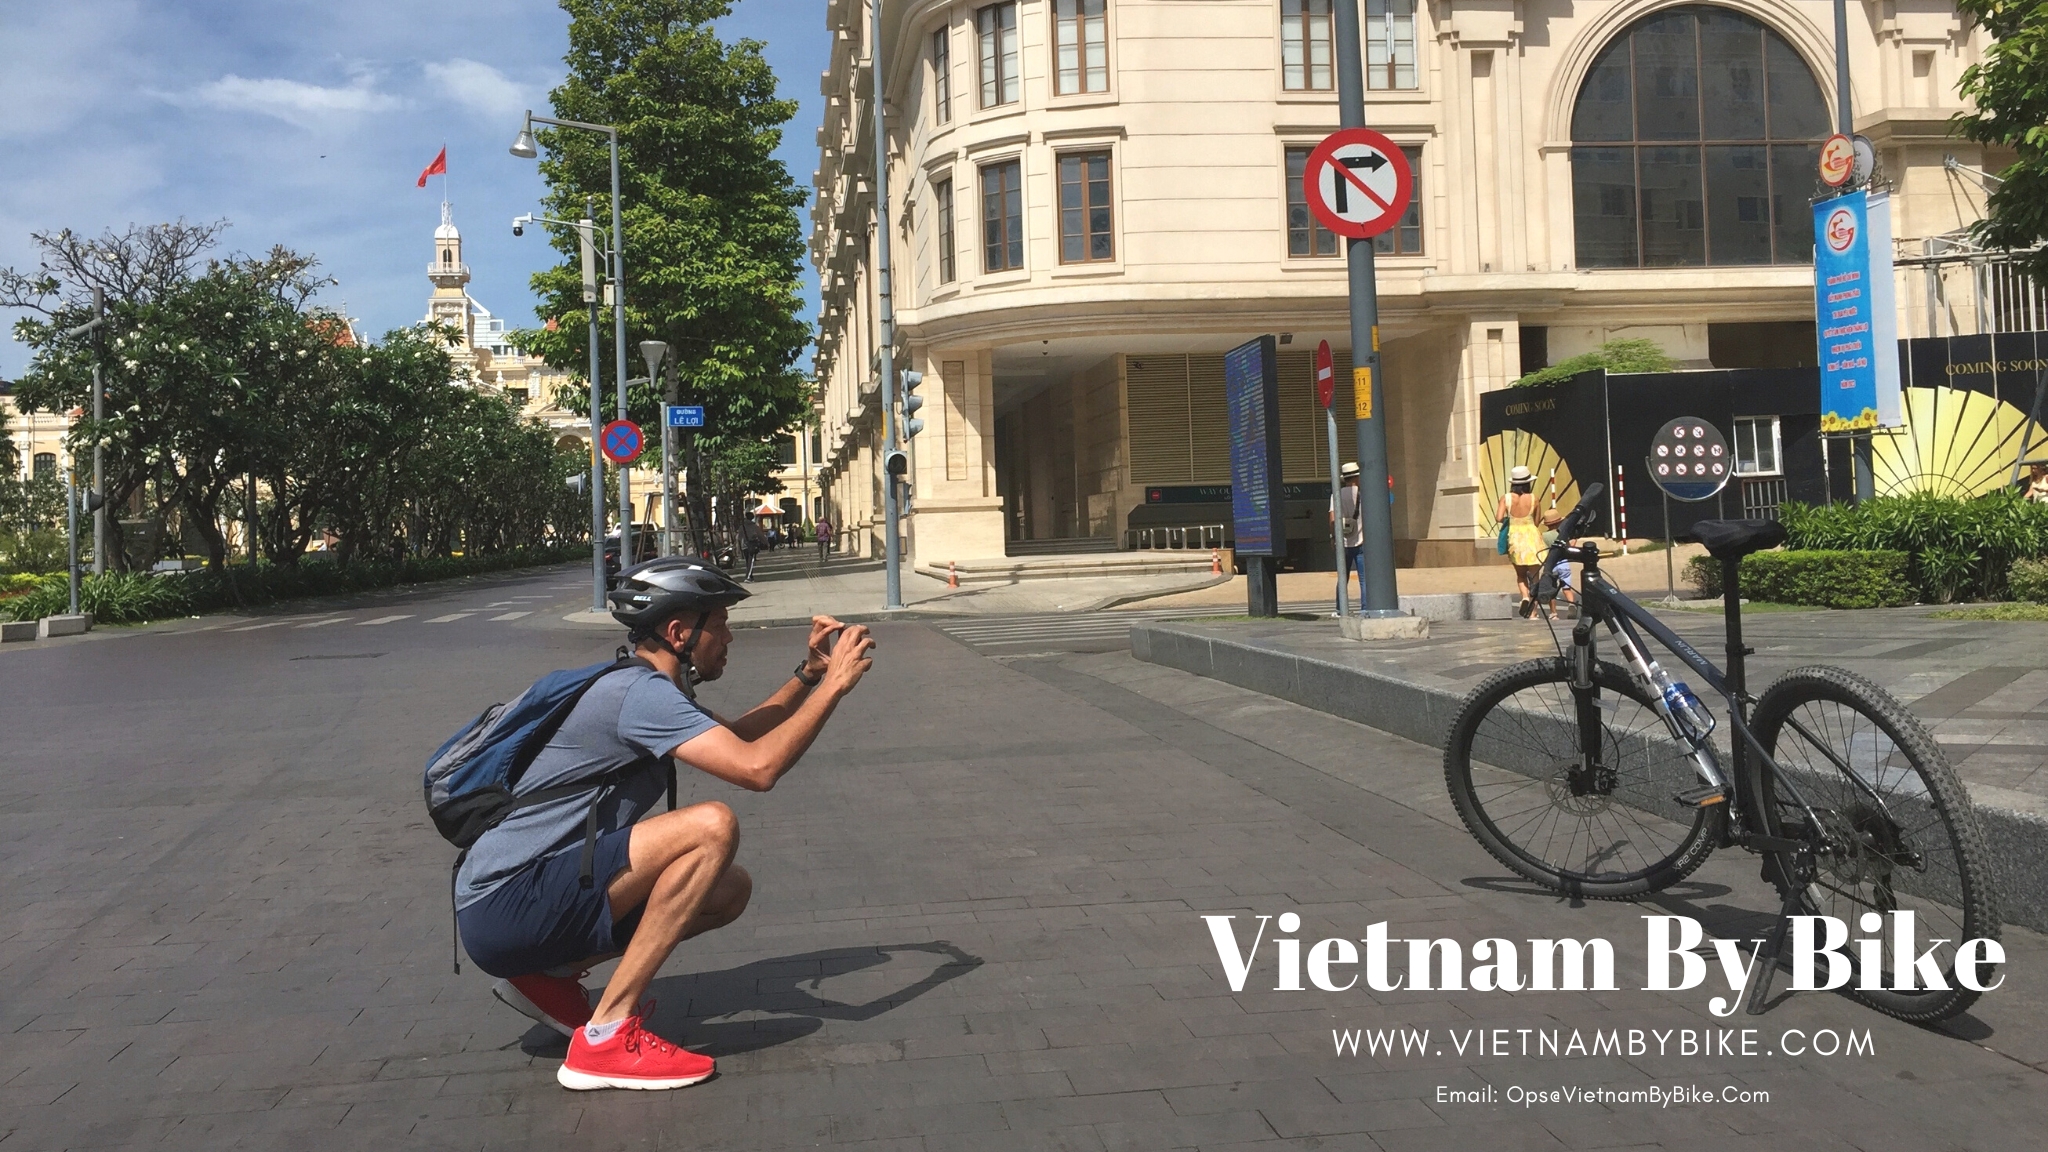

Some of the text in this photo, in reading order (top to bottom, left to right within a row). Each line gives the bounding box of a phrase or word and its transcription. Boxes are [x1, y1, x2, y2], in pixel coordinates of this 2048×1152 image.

[1945, 359, 2048, 376] COMING SOON
[1505, 398, 1557, 416] COMING SOON
[674, 416, 685, 425] LÊ
[1674, 640, 1709, 666] MARLIN
[1672, 827, 1708, 872] XR2 COMP
